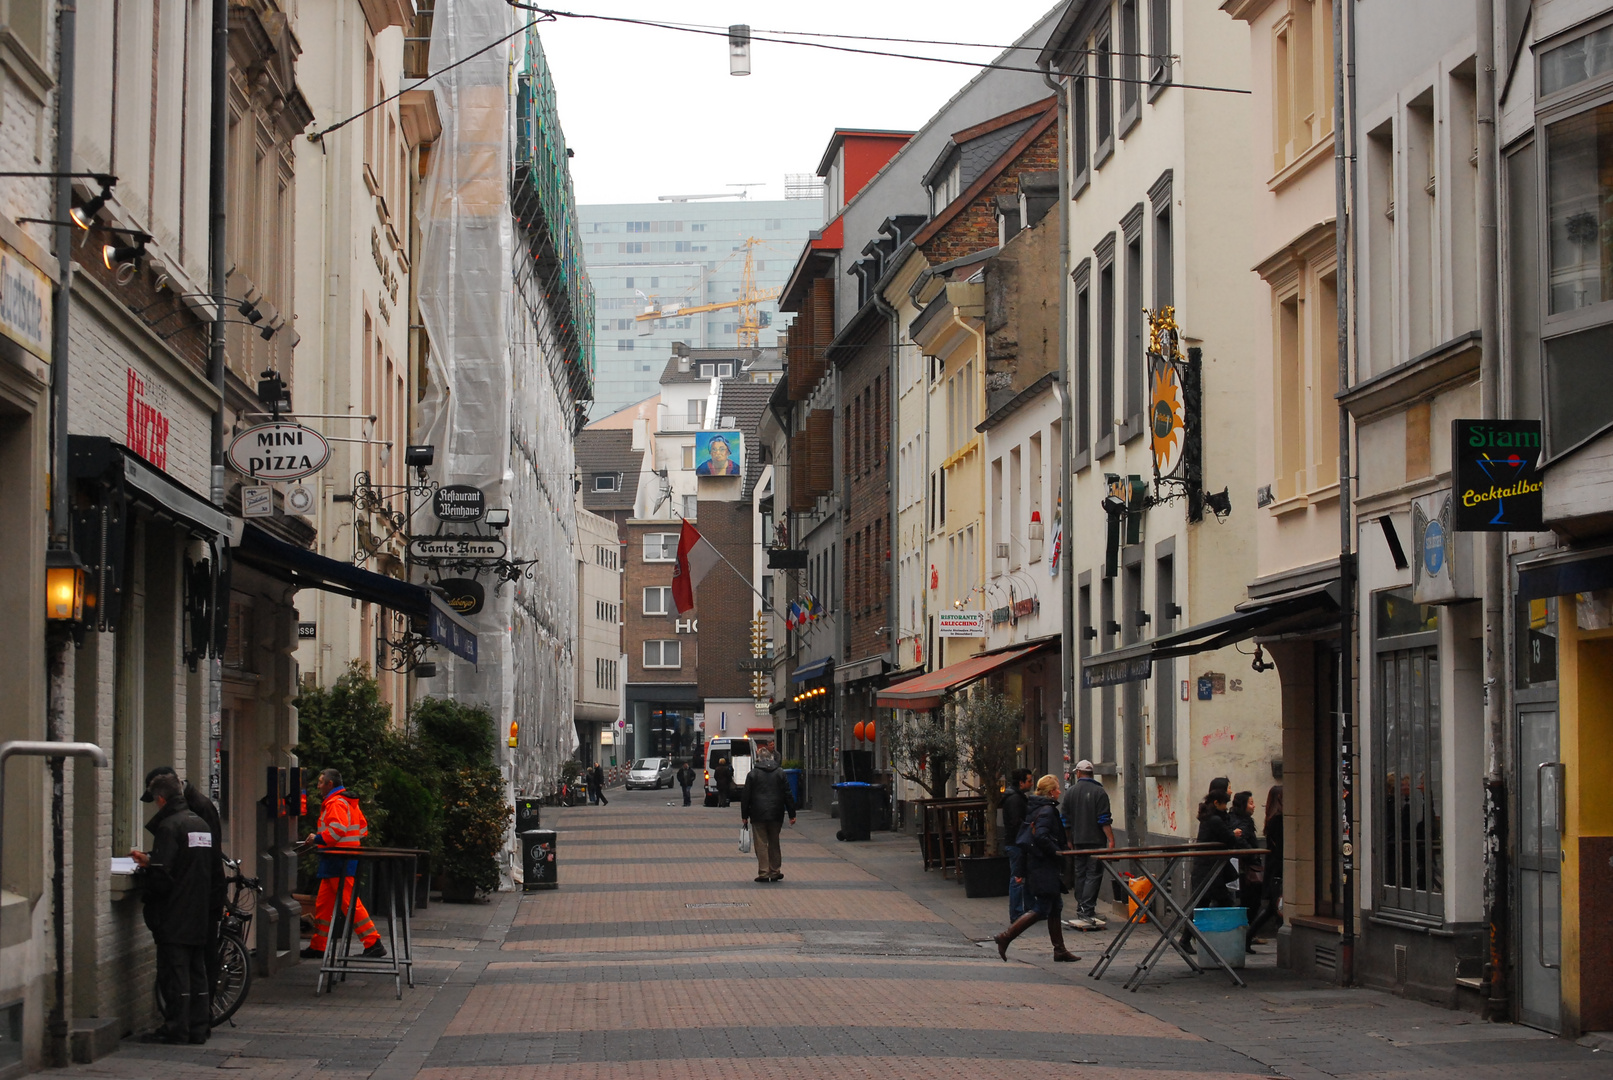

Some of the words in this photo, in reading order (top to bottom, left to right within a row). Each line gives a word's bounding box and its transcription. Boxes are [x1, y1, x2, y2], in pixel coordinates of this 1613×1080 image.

[126, 367, 169, 472] Kürzer
[1469, 426, 1540, 447] Siam
[440, 503, 480, 518] Weinhaus
[417, 541, 454, 554] Tante
[457, 541, 495, 554] Anna
[1532, 638, 1541, 664] 13
